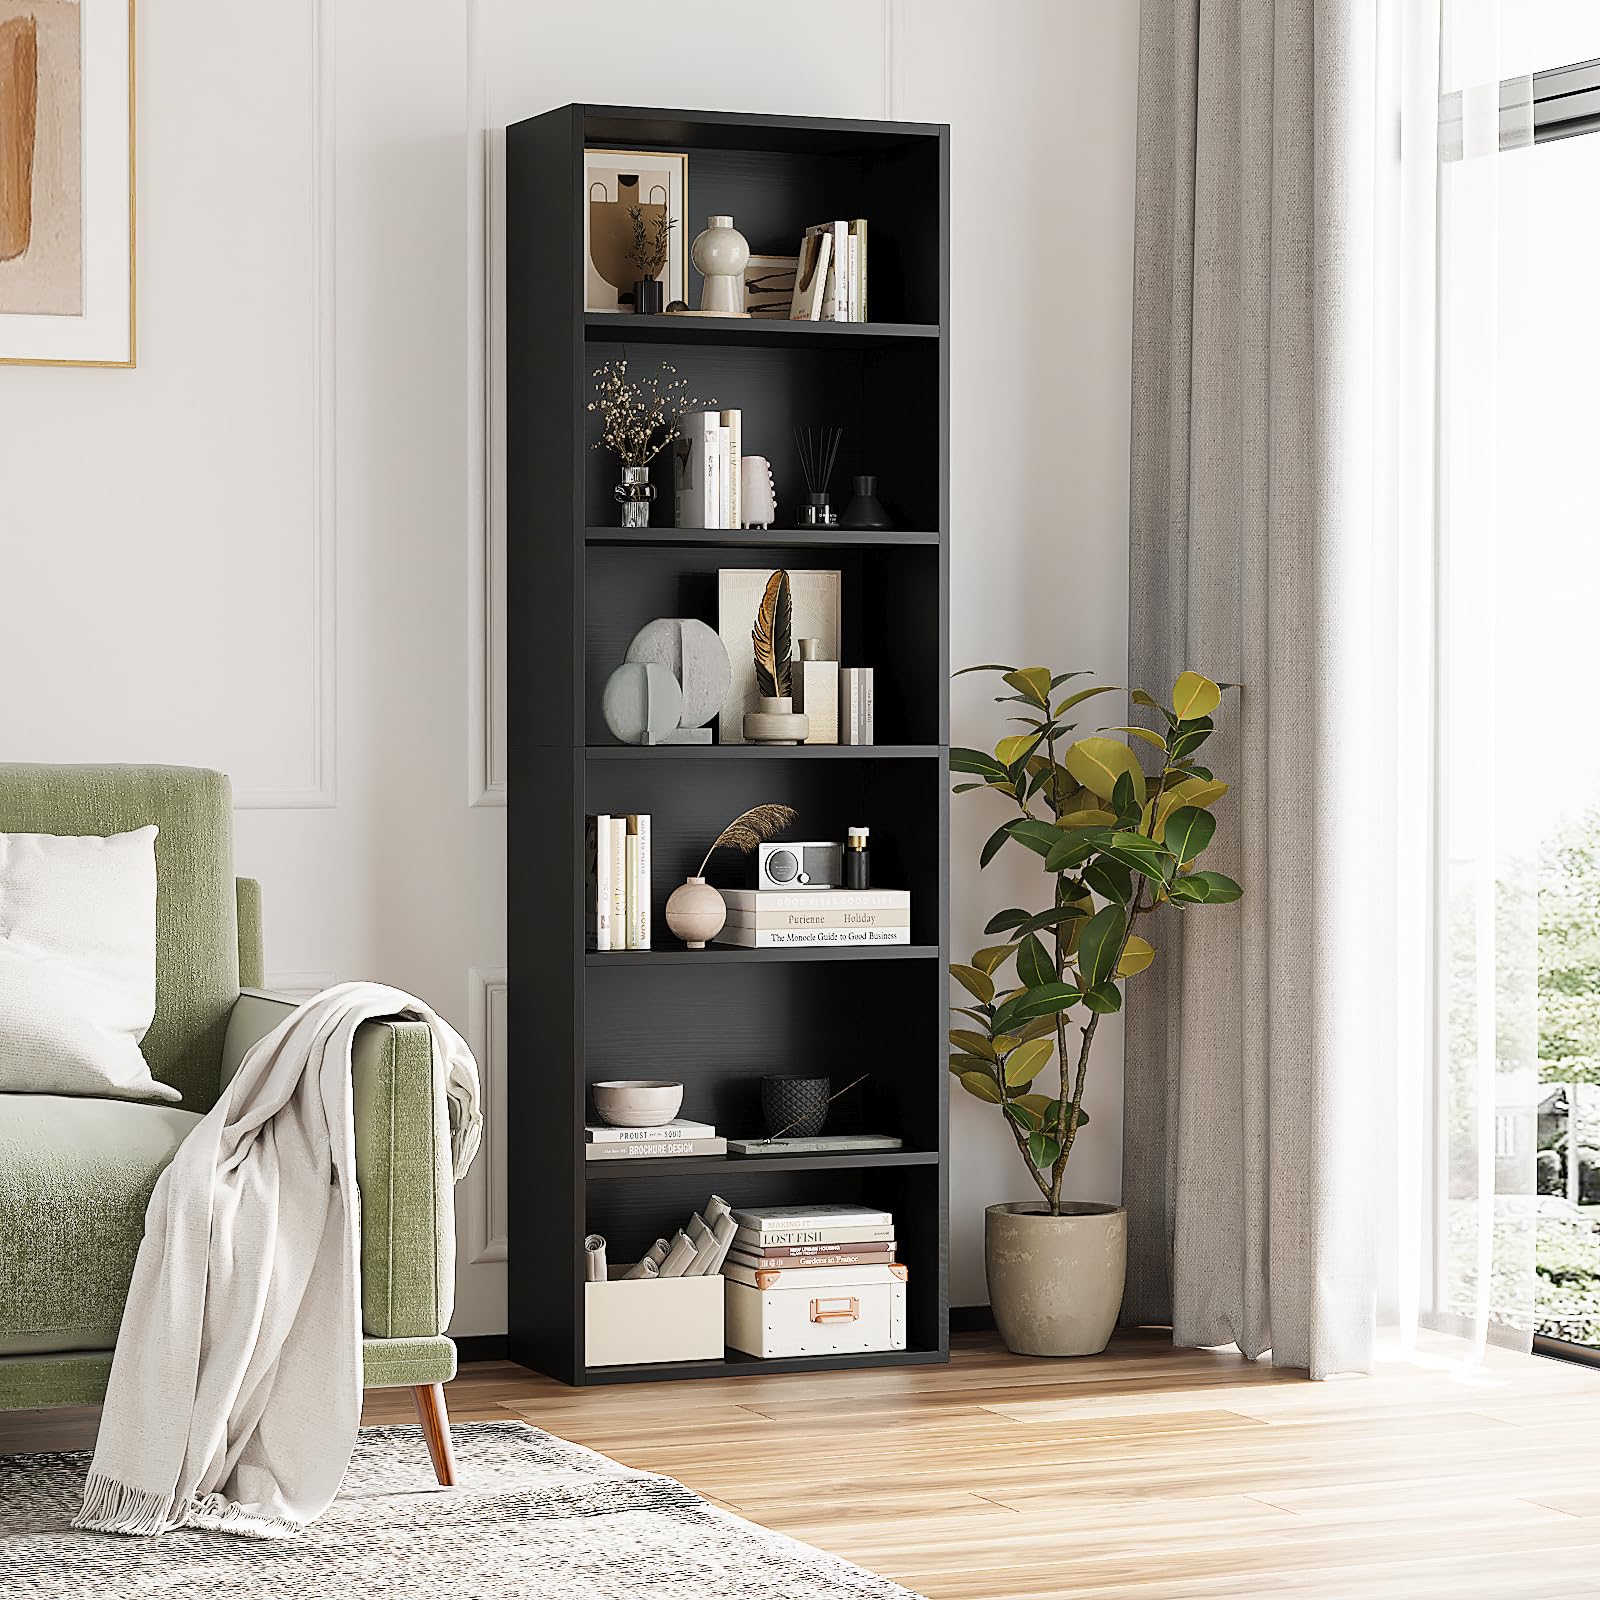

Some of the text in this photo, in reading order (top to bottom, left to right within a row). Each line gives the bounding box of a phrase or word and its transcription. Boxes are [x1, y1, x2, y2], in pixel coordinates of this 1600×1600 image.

[788, 913, 876, 924] Purienne Holiday
[771, 931, 897, 942] The Monocle Guide to Good Business
[619, 1131, 647, 1140] PROUST
[629, 1144, 666, 1155] BROCHURE
[668, 1142, 694, 1154] DESIGN
[767, 1221, 801, 1229] MAKING
[764, 1231, 823, 1245] LOST FISH
[800, 1255, 859, 1265] Gardens in France
